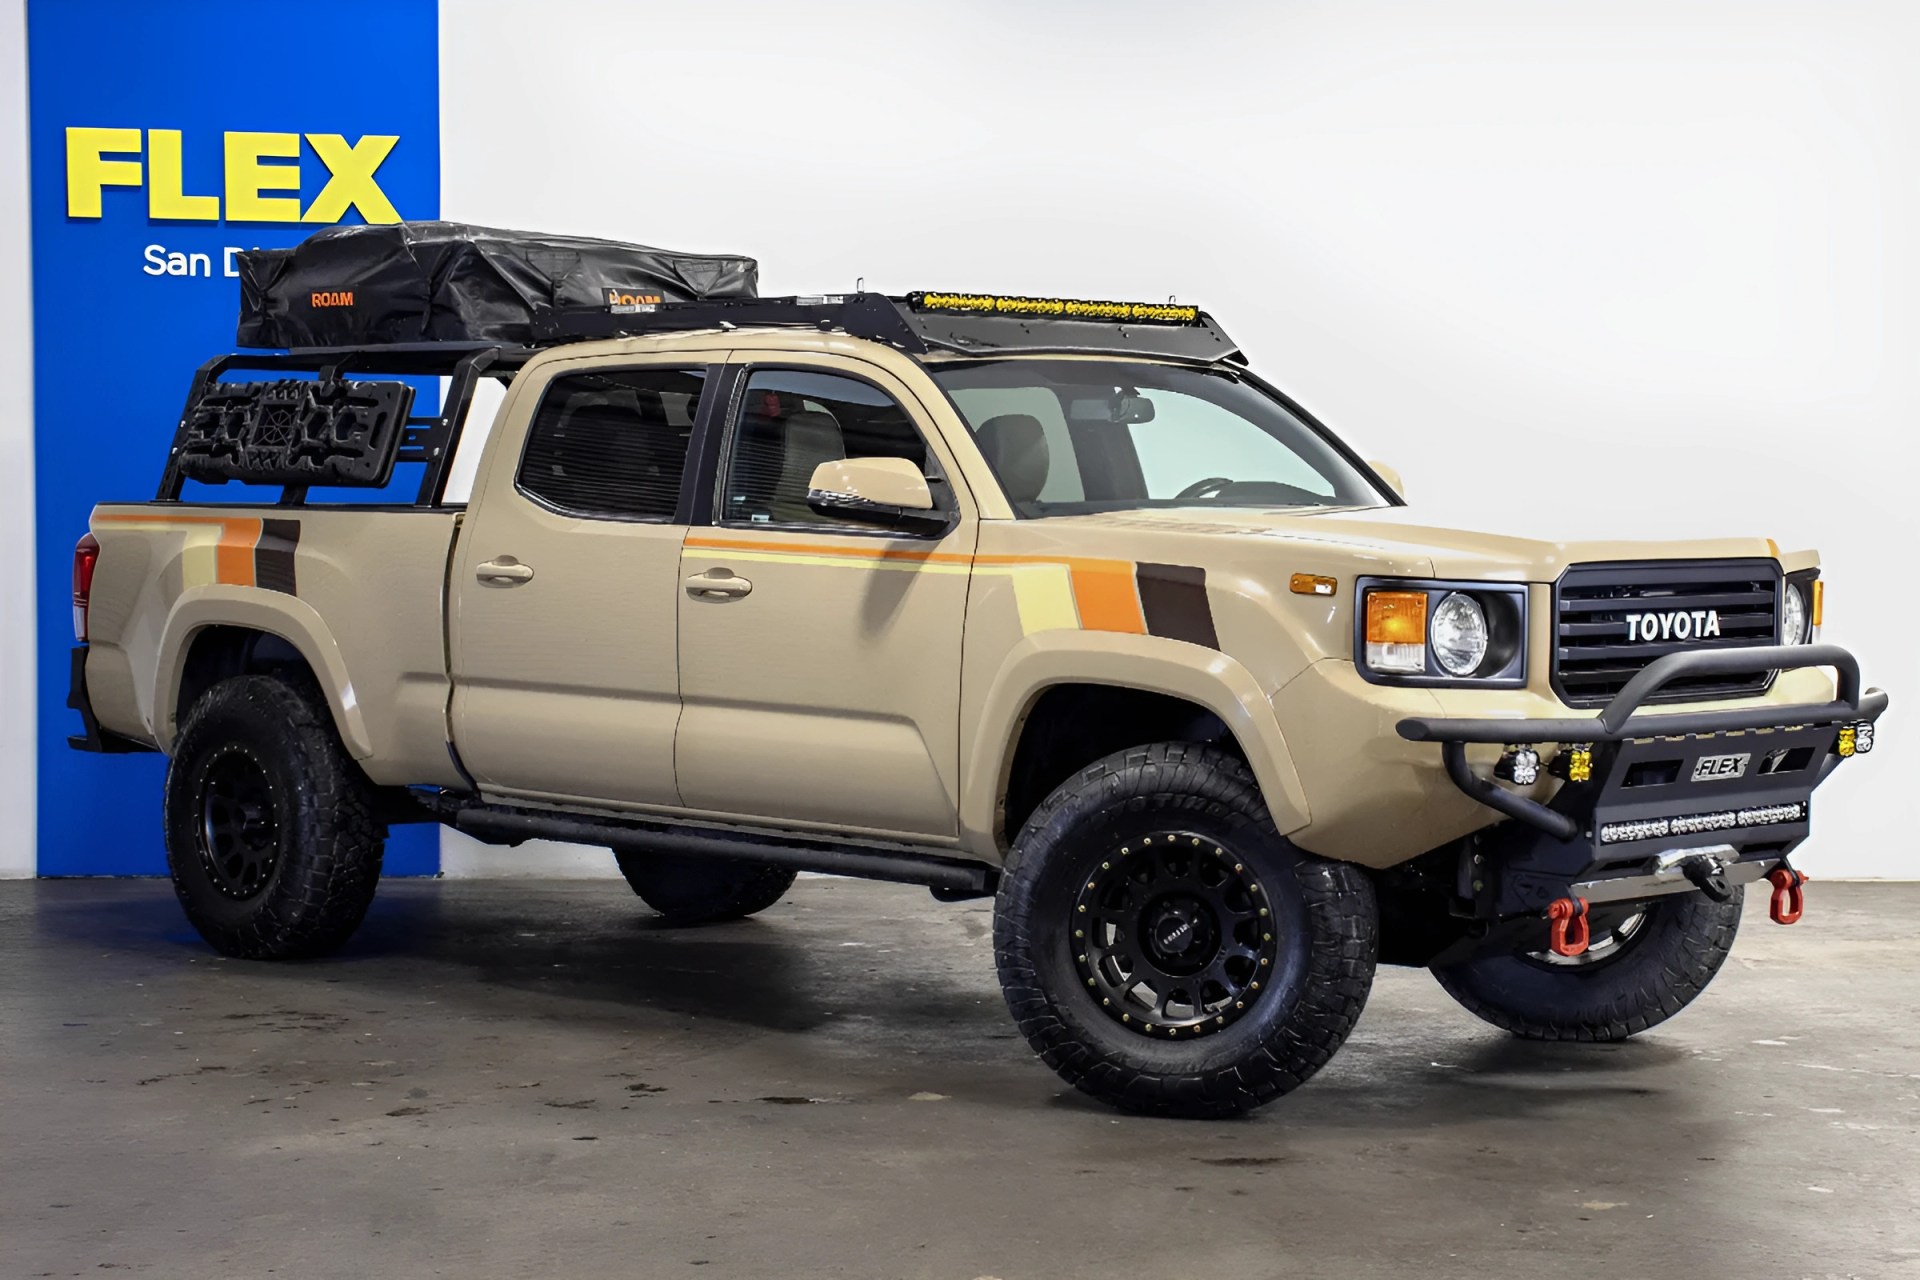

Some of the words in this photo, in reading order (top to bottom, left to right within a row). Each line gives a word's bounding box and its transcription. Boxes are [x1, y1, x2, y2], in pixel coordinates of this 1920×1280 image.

[65, 126, 404, 225] FLEX
[143, 244, 211, 278] San
[311, 291, 354, 308] ROAM
[1625, 610, 1721, 641] TOYOTA
[1697, 757, 1743, 776] FLEX
